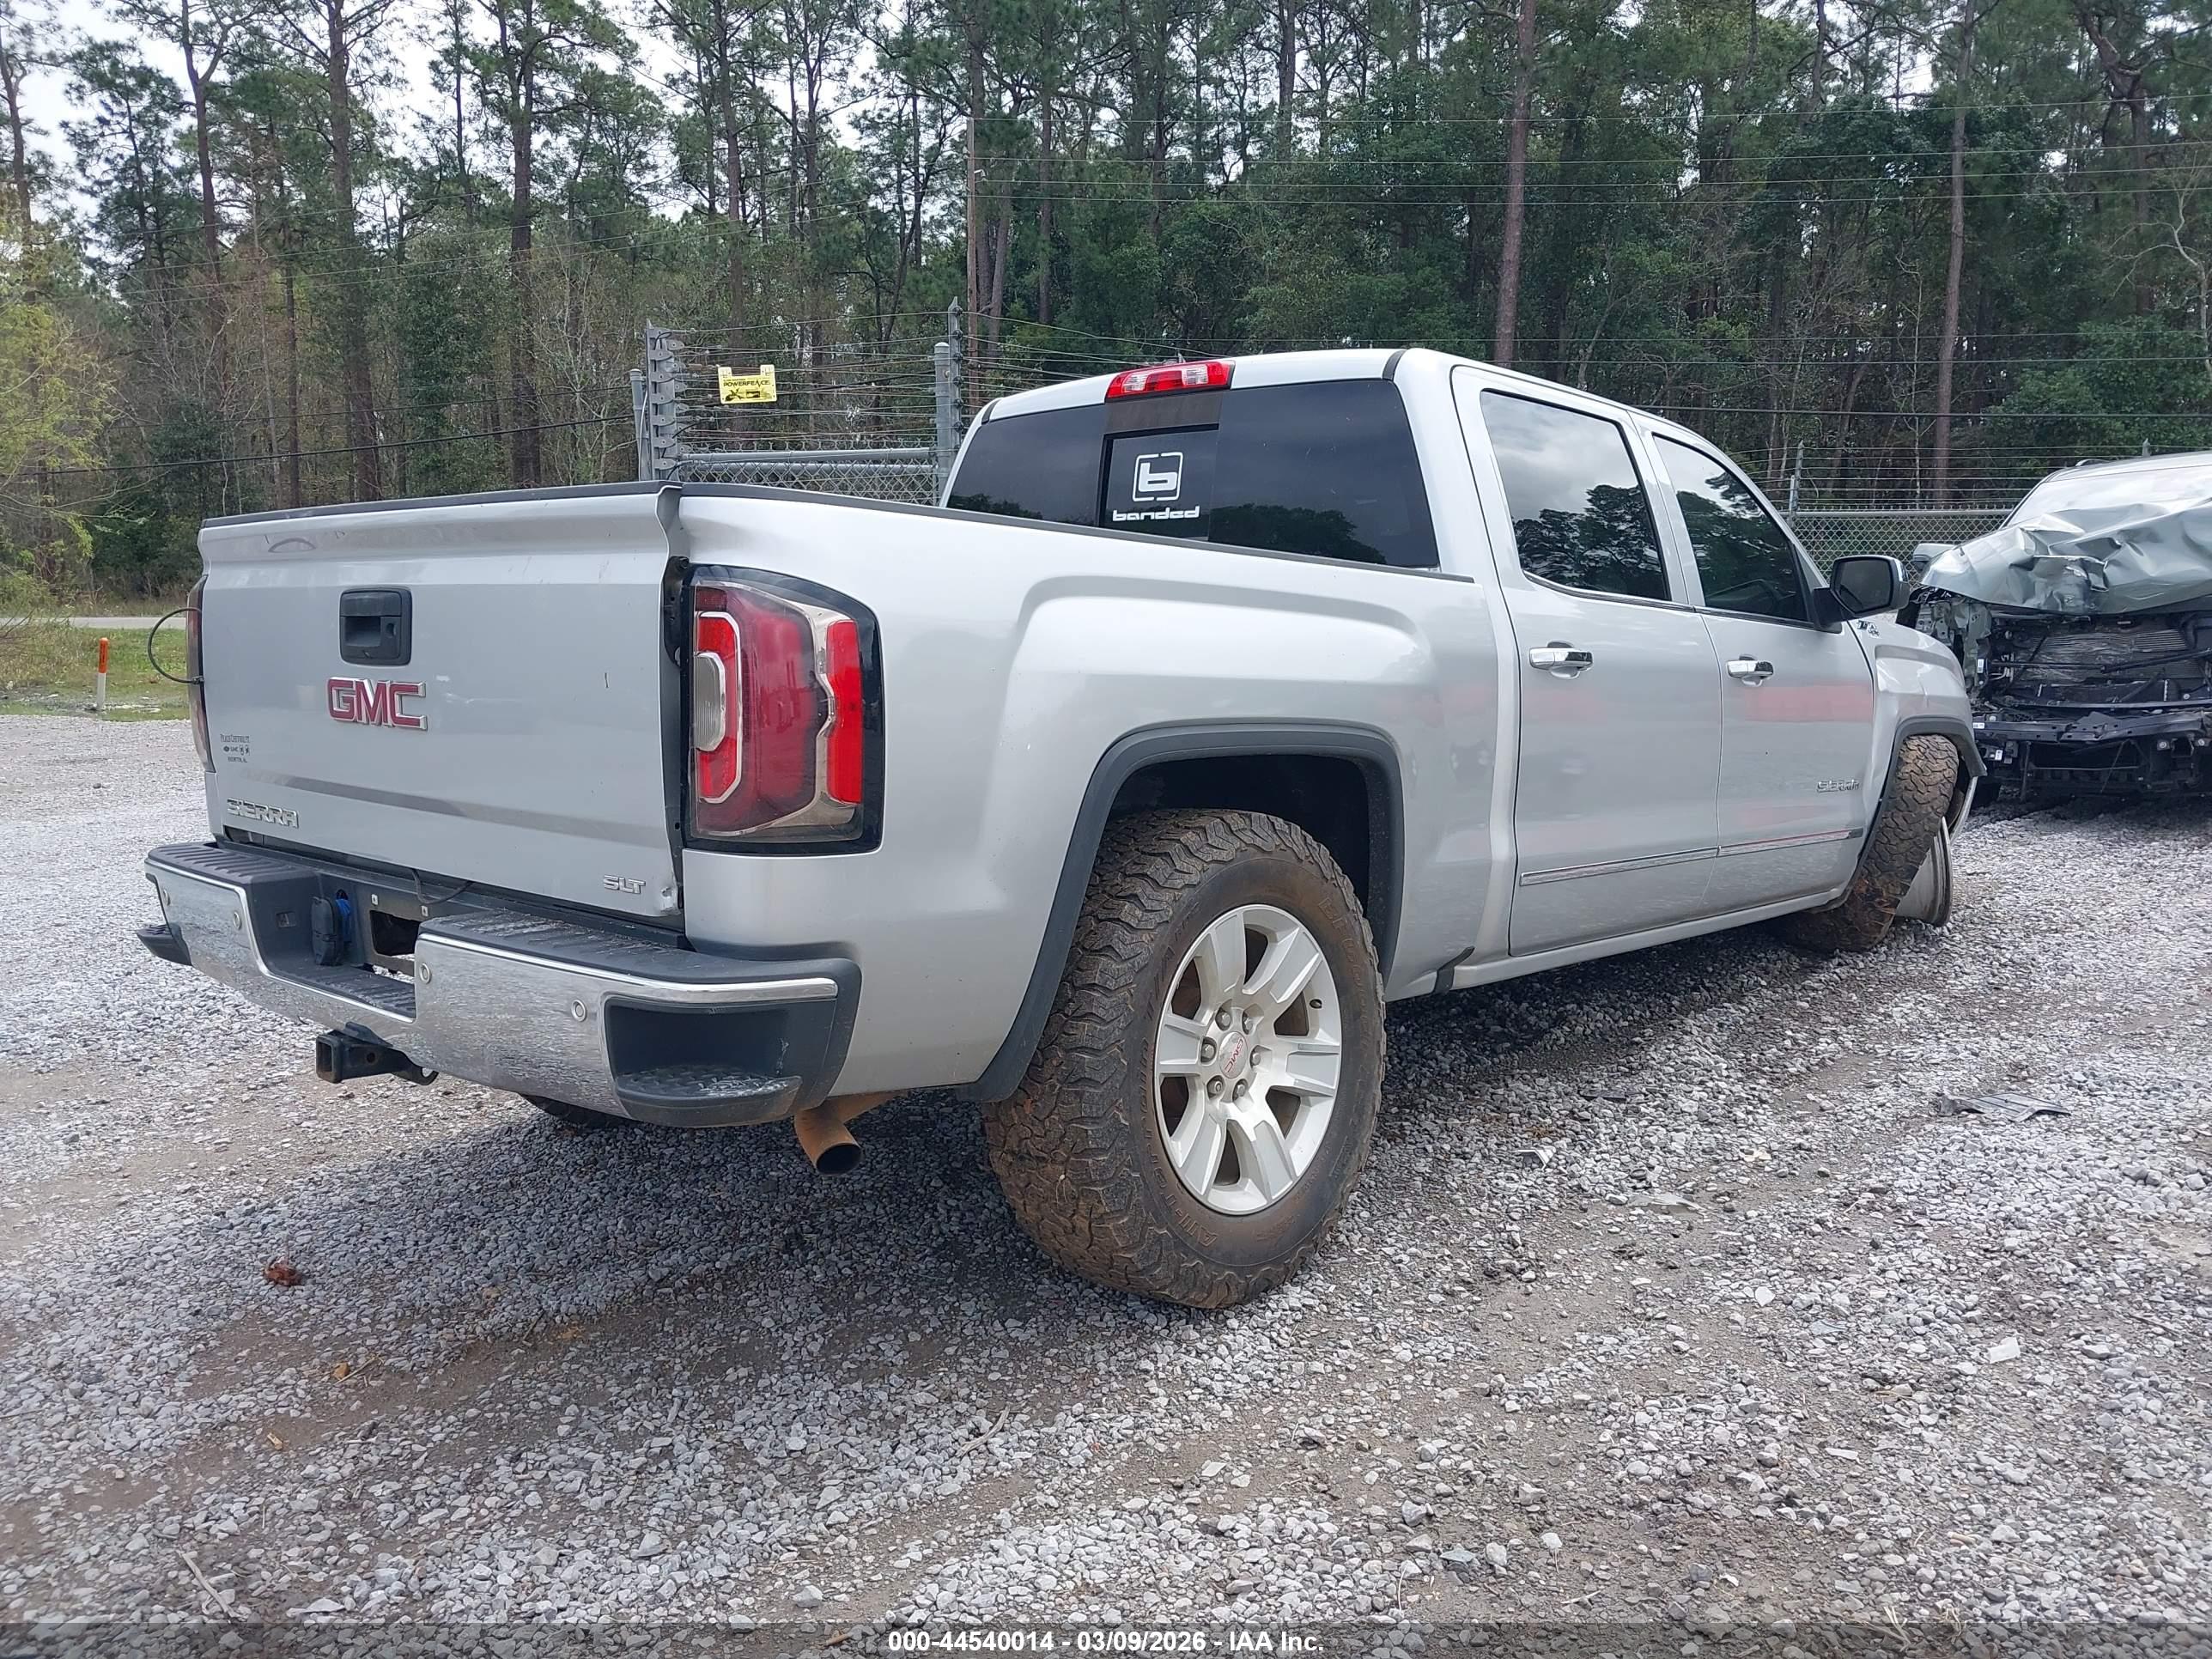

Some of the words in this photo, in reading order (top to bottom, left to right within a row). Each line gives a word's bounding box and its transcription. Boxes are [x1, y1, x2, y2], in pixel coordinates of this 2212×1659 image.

[1112, 505, 1200, 521] banded
[327, 676, 428, 731] GMC
[227, 798, 300, 829] SIERRA
[603, 874, 646, 894] SLT
[1223, 1036, 1244, 1073] GMC
